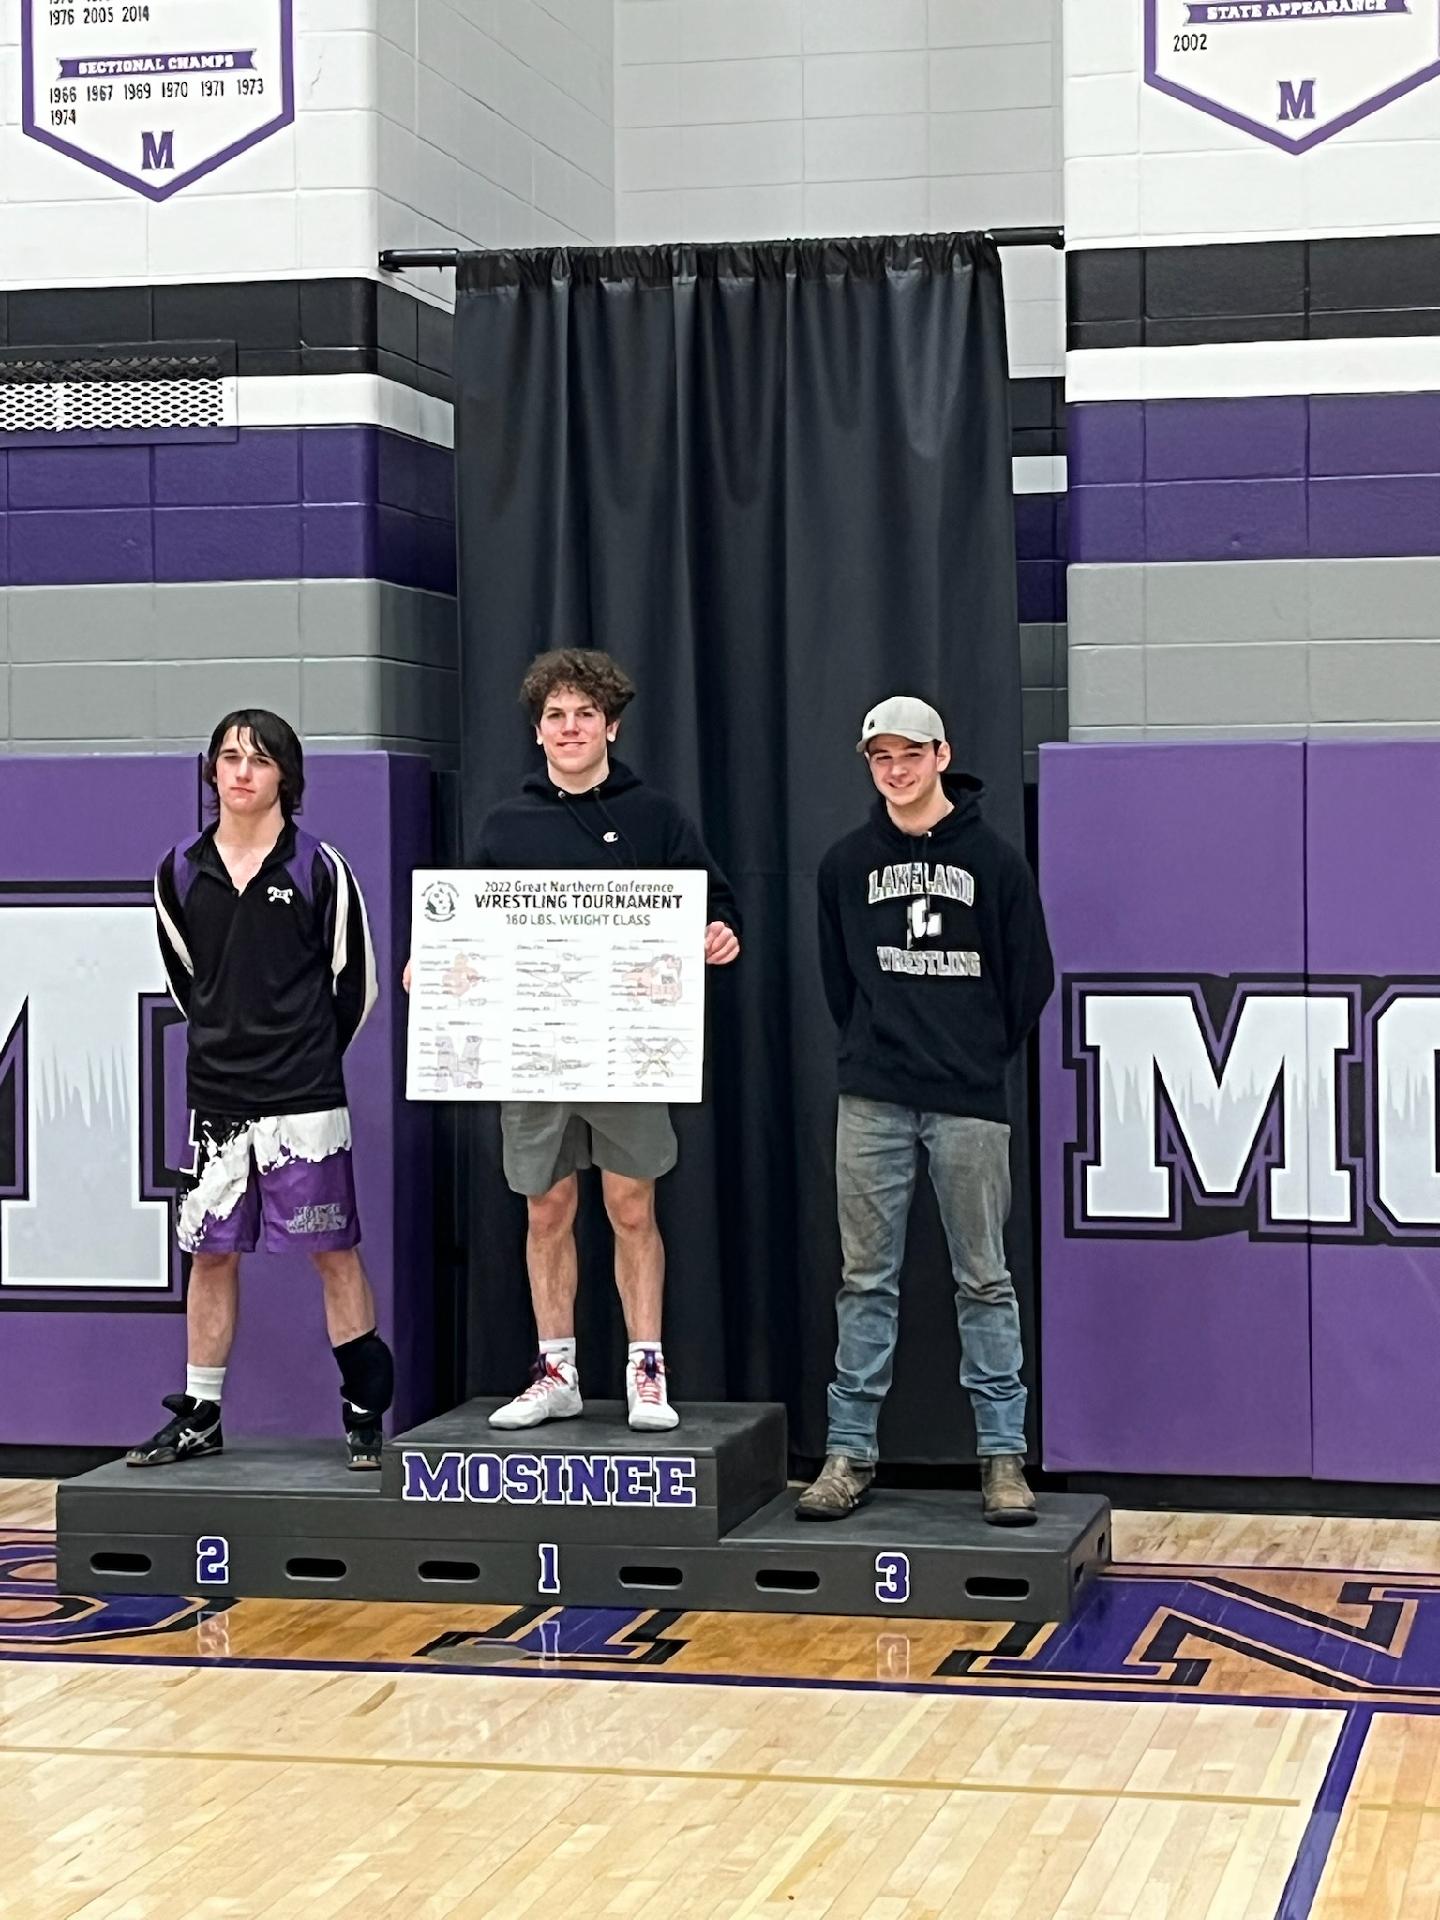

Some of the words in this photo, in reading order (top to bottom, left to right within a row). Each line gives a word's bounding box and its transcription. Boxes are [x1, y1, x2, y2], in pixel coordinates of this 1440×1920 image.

[49, 9, 75, 26] 1976
[83, 7, 114, 24] 2005
[122, 5, 150, 22] 2014
[1206, 5, 1262, 20] STATE
[1266, 0, 1387, 17] APPEARANCE
[1173, 34, 1208, 52] 2002
[78, 58, 165, 75] SECTIONAL
[168, 54, 234, 71] CHAMPS
[50, 86, 77, 104] 1966
[86, 85, 113, 102] 1967
[123, 82, 151, 100] 1969
[161, 81, 189, 98] 1970
[201, 80, 225, 97] 1971
[237, 78, 264, 95] 1973
[1277, 78, 1316, 120] M
[50, 109, 76, 126] 1974
[141, 130, 175, 170] M
[485, 881, 511, 892] 2022
[514, 880, 547, 892] Great
[550, 880, 604, 893] Northern
[607, 880, 674, 893] Conference
[868, 862, 975, 907] LAKELAND
[474, 894, 568, 909] WRESTLING
[572, 894, 683, 909] TOURNAMENT
[559, 913, 610, 926] WEIGHT
[612, 913, 652, 926] CLASS
[876, 946, 982, 977] WRESTLING
[402, 1451, 696, 1507] MOSINEE
[196, 1535, 229, 1584] 2
[538, 1543, 560, 1594] 1
[875, 1551, 910, 1603] 3
